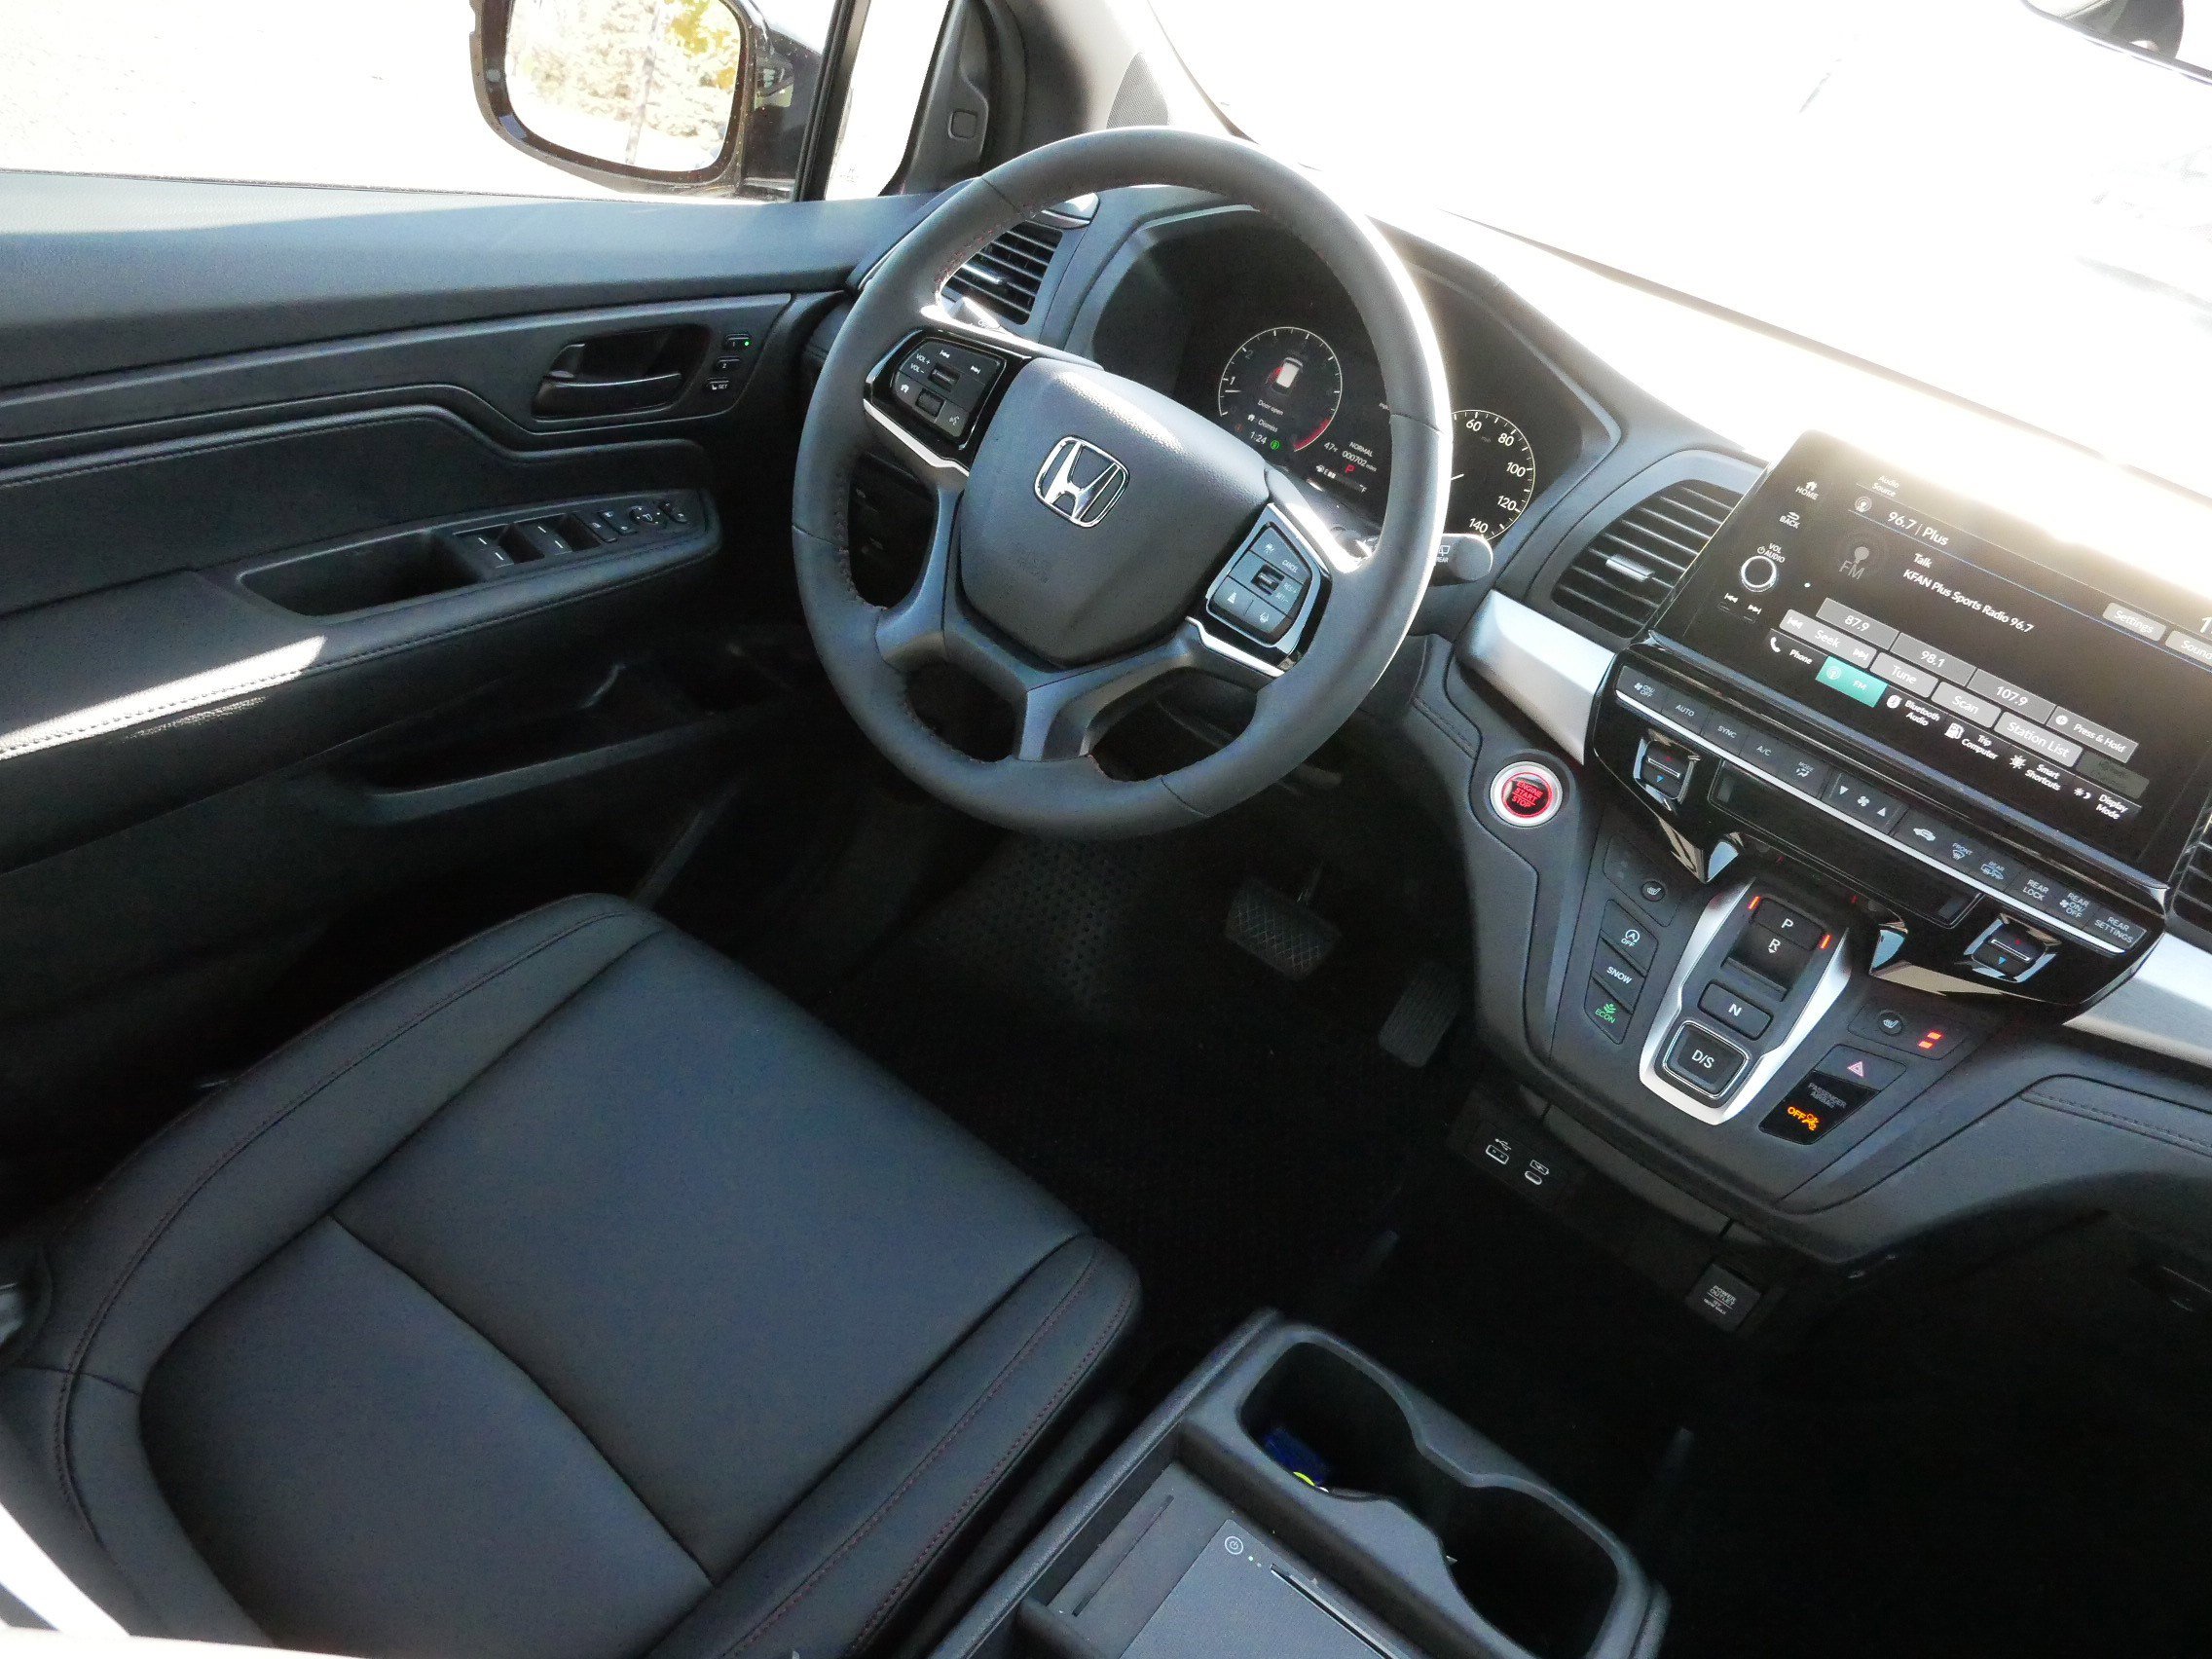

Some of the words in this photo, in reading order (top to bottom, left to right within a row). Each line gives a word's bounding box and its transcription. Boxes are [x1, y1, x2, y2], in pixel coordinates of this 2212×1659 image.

[1230, 376, 1236, 386] 1
[1465, 420, 1483, 432] 60
[1250, 431, 1268, 445] 1:24
[1497, 432, 1515, 447] 80
[1349, 442, 1373, 458] NORMAL
[1342, 451, 1368, 467] 000702
[1345, 464, 1356, 474] P
[1506, 461, 1527, 478] 100
[1878, 475, 1899, 489] Audio
[1795, 487, 1819, 500] HOME
[1872, 483, 1897, 498] Source
[1496, 496, 1517, 511] 120
[1468, 518, 1489, 534] 140
[1780, 515, 1801, 529] BACK
[1888, 511, 1916, 531] 96.7
[1922, 527, 1949, 546] Plus
[1764, 549, 1786, 564] AUDIO
[1768, 543, 1783, 554] VOL
[1282, 559, 1298, 573] CANCEL
[1913, 553, 1933, 569] Talk
[1839, 560, 1865, 579] FM
[1902, 569, 1933, 588] KFAN
[1931, 581, 1951, 597] Plus
[1951, 591, 1982, 611] Sports
[1982, 605, 2009, 623] Radio
[2009, 617, 2035, 633] 96.7
[1844, 614, 1870, 632] 87.9
[2114, 610, 2155, 634] Settings
[1814, 630, 1841, 648] Seek
[1788, 648, 1813, 665] Phone
[1920, 650, 1945, 668] 98.1
[1892, 665, 1917, 684] Tune
[1852, 680, 1868, 691] FM
[1996, 685, 2029, 707] 107.9
[1675, 704, 1695, 718] AUTO
[1904, 700, 1941, 721] Bluetooth
[1951, 695, 1979, 715] Scan
[1905, 712, 1929, 726] Audio
[1717, 725, 1737, 739] SYNC
[2007, 721, 2046, 746] Station
[2046, 741, 2070, 757] List
[2073, 723, 2096, 739] Press
[2095, 733, 2104, 743] &
[2103, 736, 2127, 754] Hold
[1977, 734, 1993, 747] Trip
[1756, 745, 1772, 756] A/C
[1961, 738, 1999, 760] Computer
[2037, 763, 2060, 780] Smart
[2025, 769, 2062, 792] Shortcuts
[1513, 787, 1538, 803] START
[1516, 780, 1544, 798] ENGINE
[1512, 795, 1531, 808] STOP
[2098, 793, 2129, 813] Display
[2095, 803, 2121, 820] Mode
[1952, 842, 1973, 856] FRONT
[1989, 861, 2006, 871] REAR
[2022, 886, 2045, 902] LOCK
[2027, 879, 2049, 895] REAR
[2067, 892, 2089, 907] REAR
[2066, 907, 2083, 919] OFF
[1781, 918, 1794, 930] P
[2094, 919, 2134, 943] SETTINGS
[2108, 916, 2130, 932] REAR
[1621, 938, 1636, 947] OFF
[1768, 938, 1781, 951] R
[1606, 966, 1633, 984] SNOW
[1595, 1008, 1616, 1023] ECON
[1728, 1003, 1742, 1017] N
[1691, 1049, 1715, 1069] D/S
[1808, 1082, 1847, 1108] PASSENGER
[1810, 1090, 1835, 1108] AIRBAG
[1788, 1106, 1806, 1121] OFF
[1710, 1288, 1733, 1306] OUTLET
[1713, 1285, 1736, 1304] POWER
